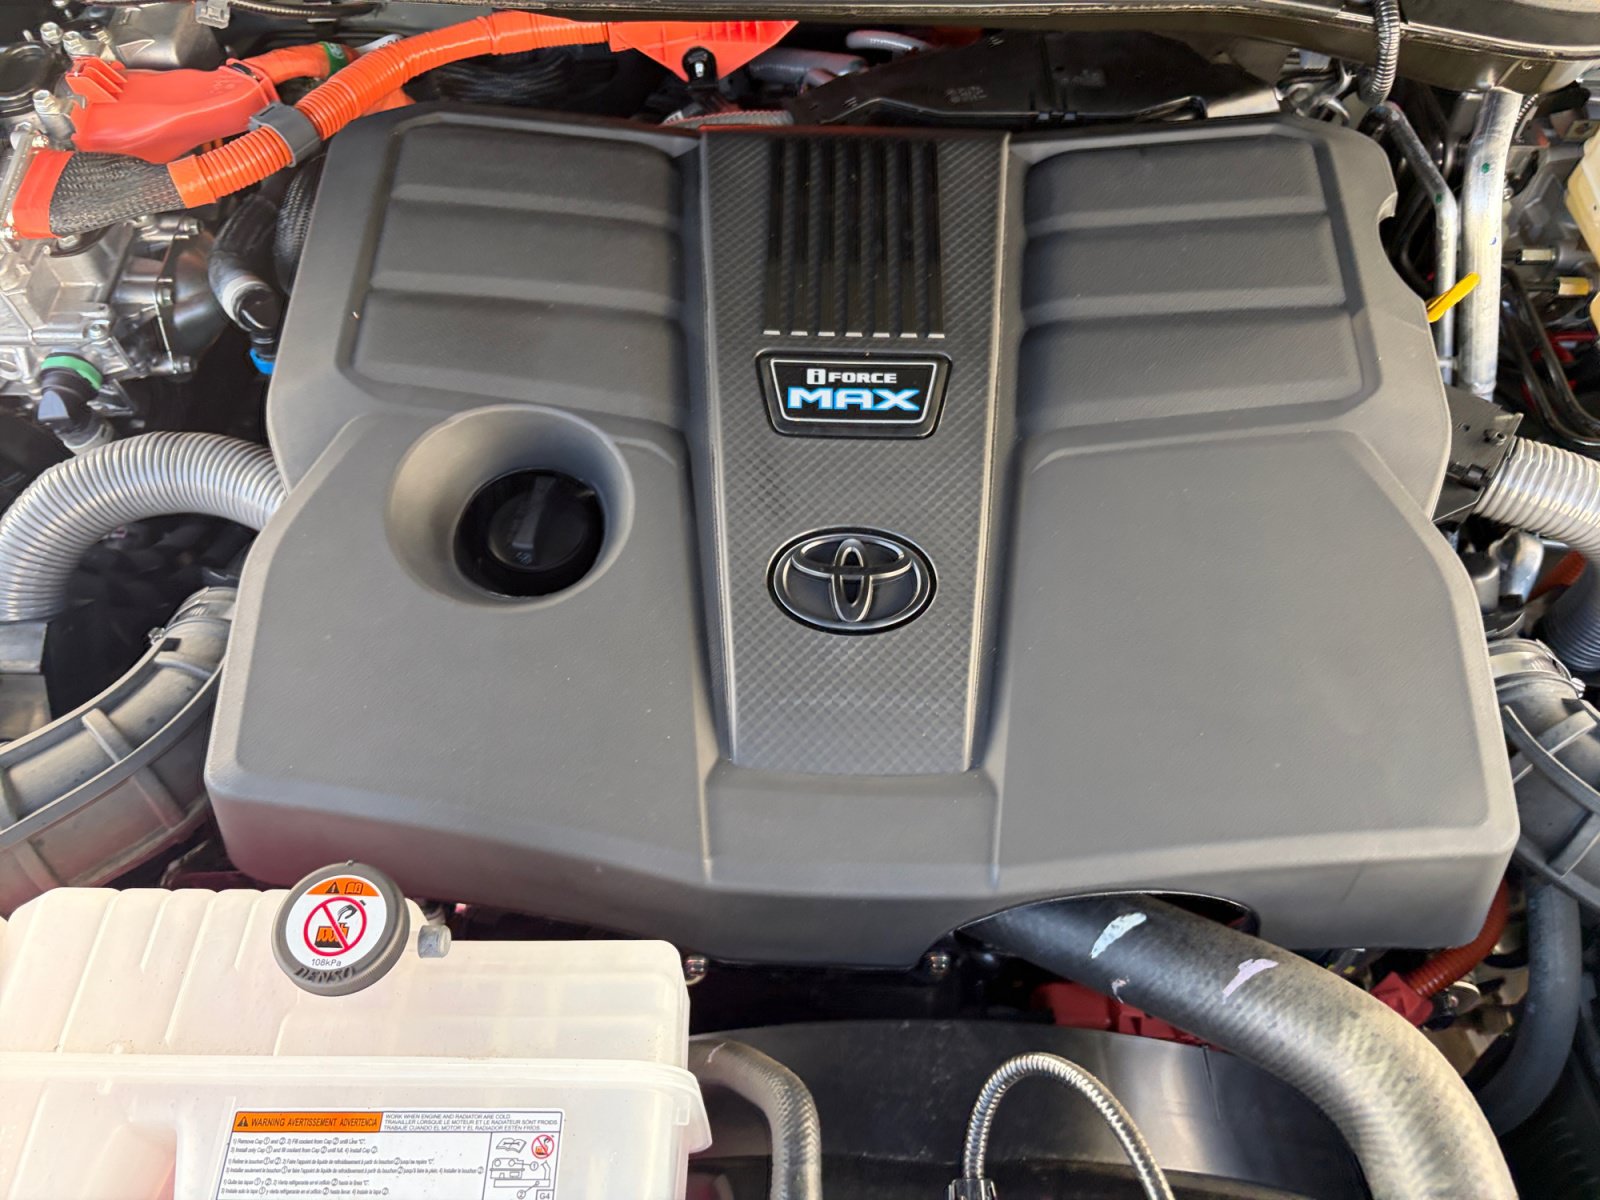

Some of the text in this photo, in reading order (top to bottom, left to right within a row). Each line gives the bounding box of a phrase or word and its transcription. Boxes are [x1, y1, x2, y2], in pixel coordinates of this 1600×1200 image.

[787, 386, 920, 411] MAX
[311, 958, 342, 967] 108kPa
[251, 1117, 377, 1127] WARNING AVERTISSEMENT ADVERTENCIA
